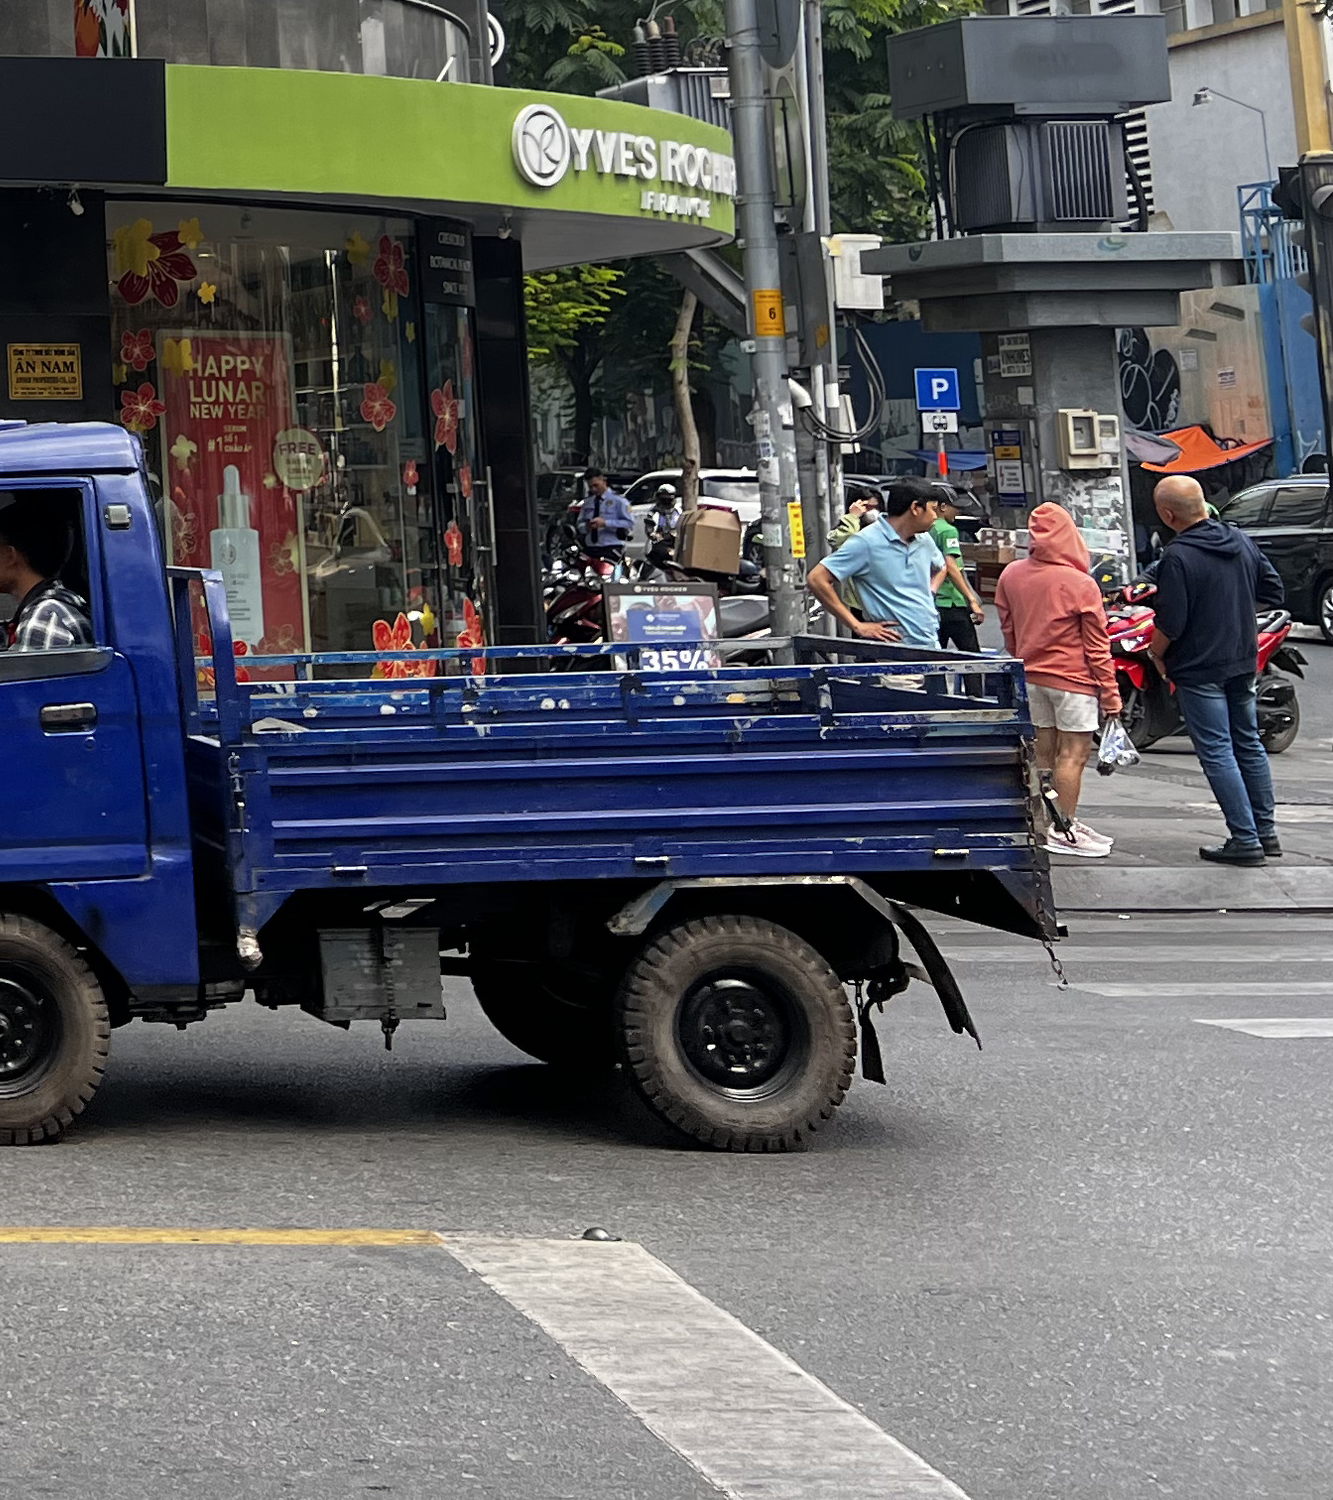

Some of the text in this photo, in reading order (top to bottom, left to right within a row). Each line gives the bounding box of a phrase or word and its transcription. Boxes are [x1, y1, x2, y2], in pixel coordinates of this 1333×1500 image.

[571, 128, 657, 180] YVES
[641, 191, 711, 218] FRANCE
[768, 307, 777, 320] 6
[40, 360, 76, 374] NAM
[189, 355, 265, 378] HAPPY
[189, 380, 266, 403] LUNAR
[931, 378, 949, 400] P
[190, 404, 267, 419] NEW YEAR
[278, 442, 317, 456] FREE
[641, 650, 709, 671] 35%
